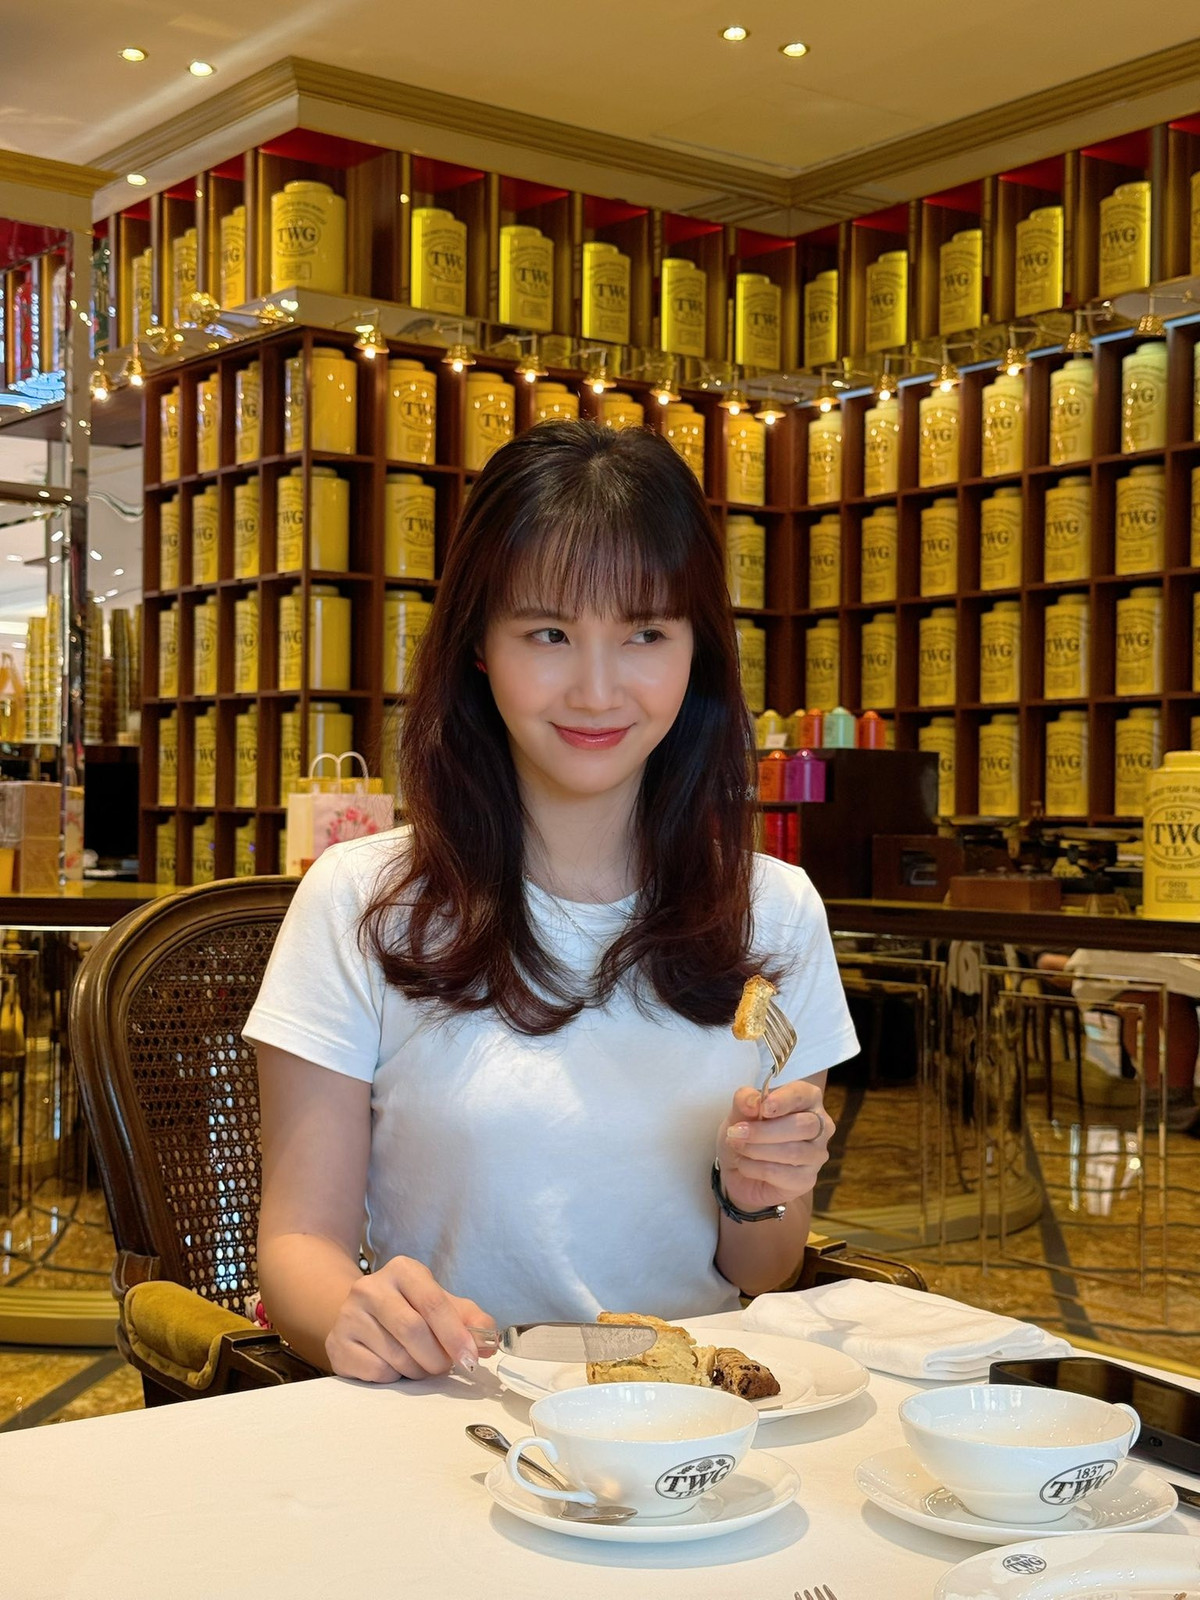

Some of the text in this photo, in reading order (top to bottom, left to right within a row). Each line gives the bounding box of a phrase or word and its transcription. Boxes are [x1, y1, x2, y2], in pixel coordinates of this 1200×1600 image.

[277, 226, 317, 243] TWG
[1120, 510, 1156, 528] TWG
[1164, 845, 1193, 857] TEA
[664, 1464, 731, 1492] TWG
[1075, 1463, 1104, 1480] 1837
[675, 1487, 706, 1498] TEA
[1048, 1469, 1113, 1499] TWG
[1006, 1556, 1043, 1571] TWG
[1026, 1566, 1042, 1574] TEA
